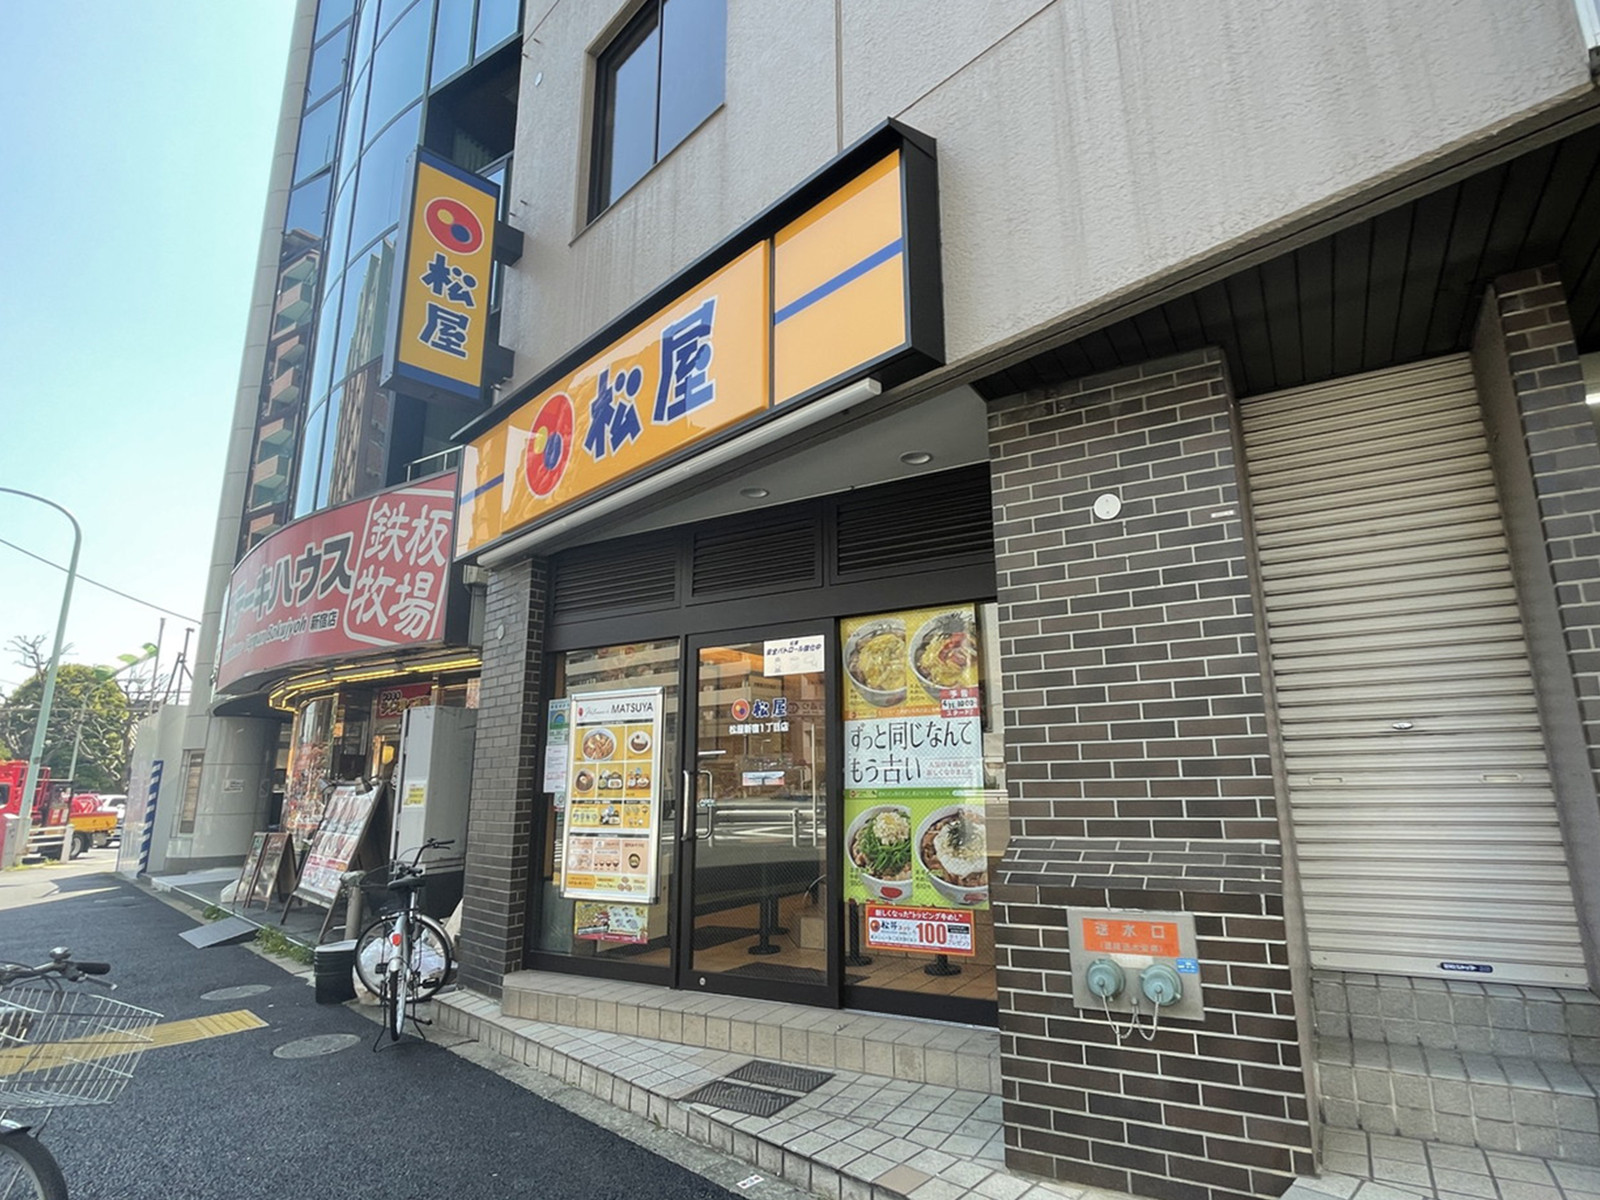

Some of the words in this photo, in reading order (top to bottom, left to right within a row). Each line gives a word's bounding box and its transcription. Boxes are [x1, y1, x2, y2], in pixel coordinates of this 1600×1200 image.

[418, 251, 479, 360] 松屋
[583, 295, 719, 462] 松屋
[364, 502, 453, 567] 鉄板
[350, 564, 435, 639] 牧場
[610, 702, 654, 715] MATSUYA
[751, 697, 788, 718] 松屋
[851, 720, 973, 751] ずっと同じなんて
[850, 754, 921, 783] もう古い
[916, 923, 948, 944] 100
[1095, 922, 1165, 939] 送水口
